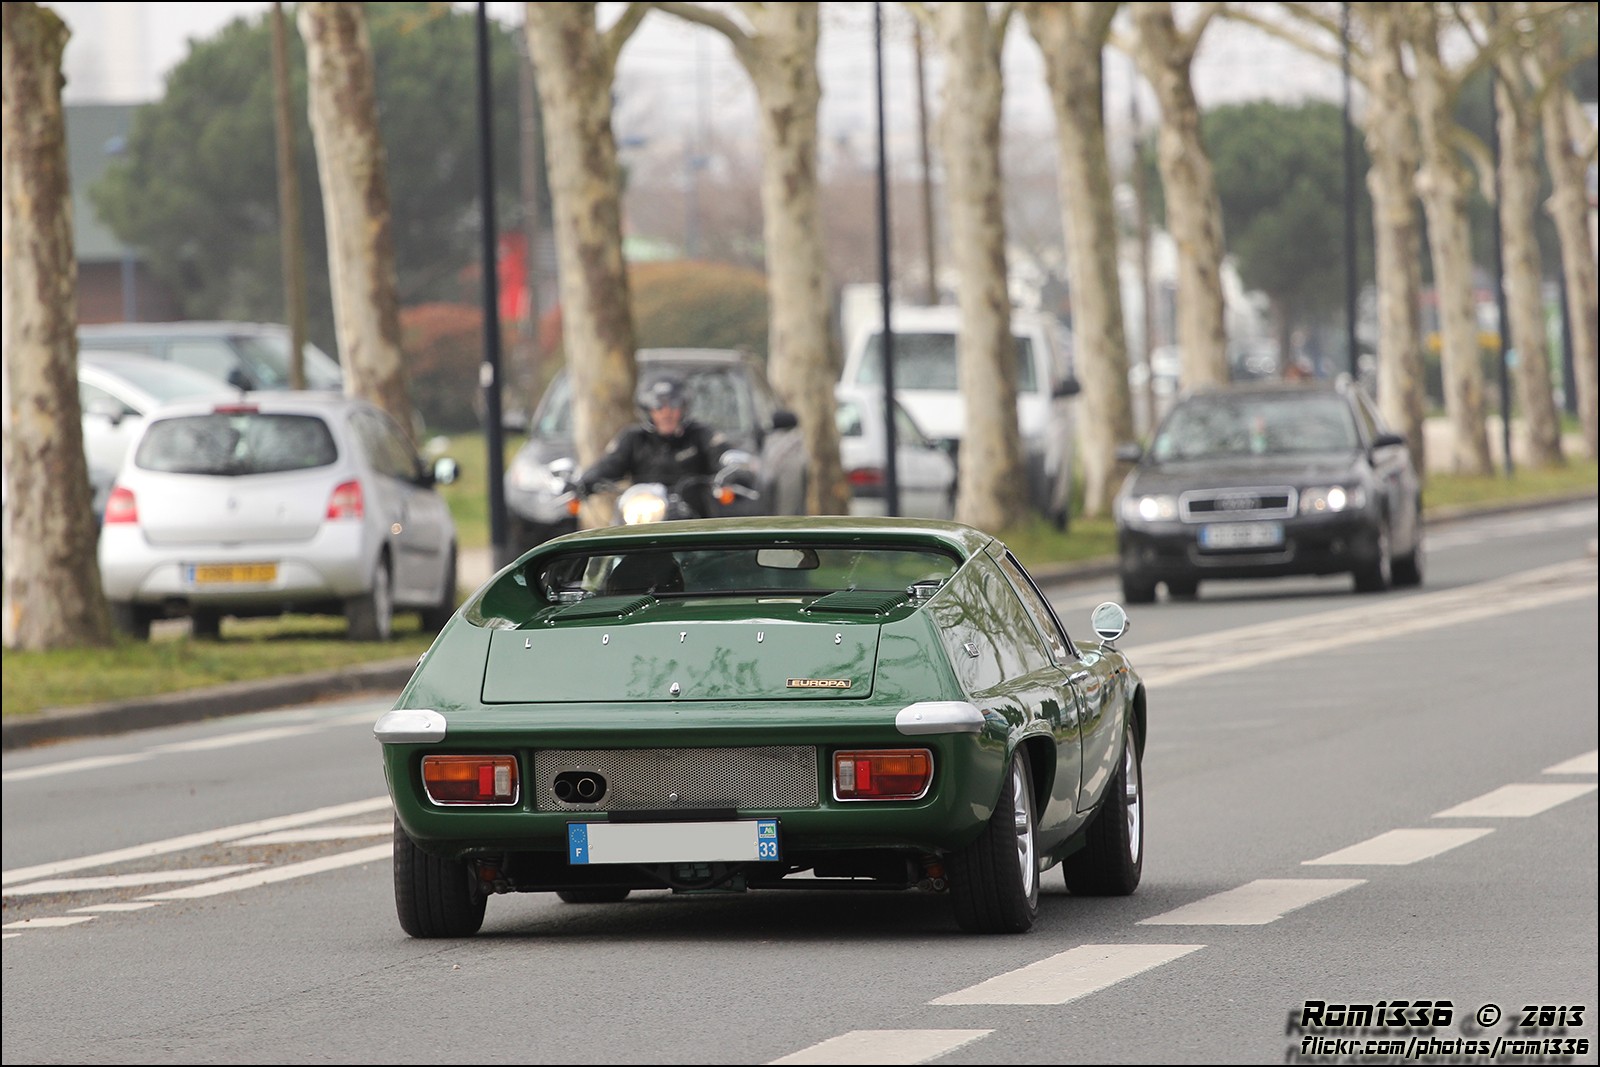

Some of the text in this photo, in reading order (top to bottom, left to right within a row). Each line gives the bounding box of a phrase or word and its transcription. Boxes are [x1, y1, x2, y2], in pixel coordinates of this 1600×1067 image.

[525, 631, 843, 649] LOTUS
[792, 679, 847, 688] EUROPA
[575, 847, 582, 857] F
[759, 842, 777, 857] 33
